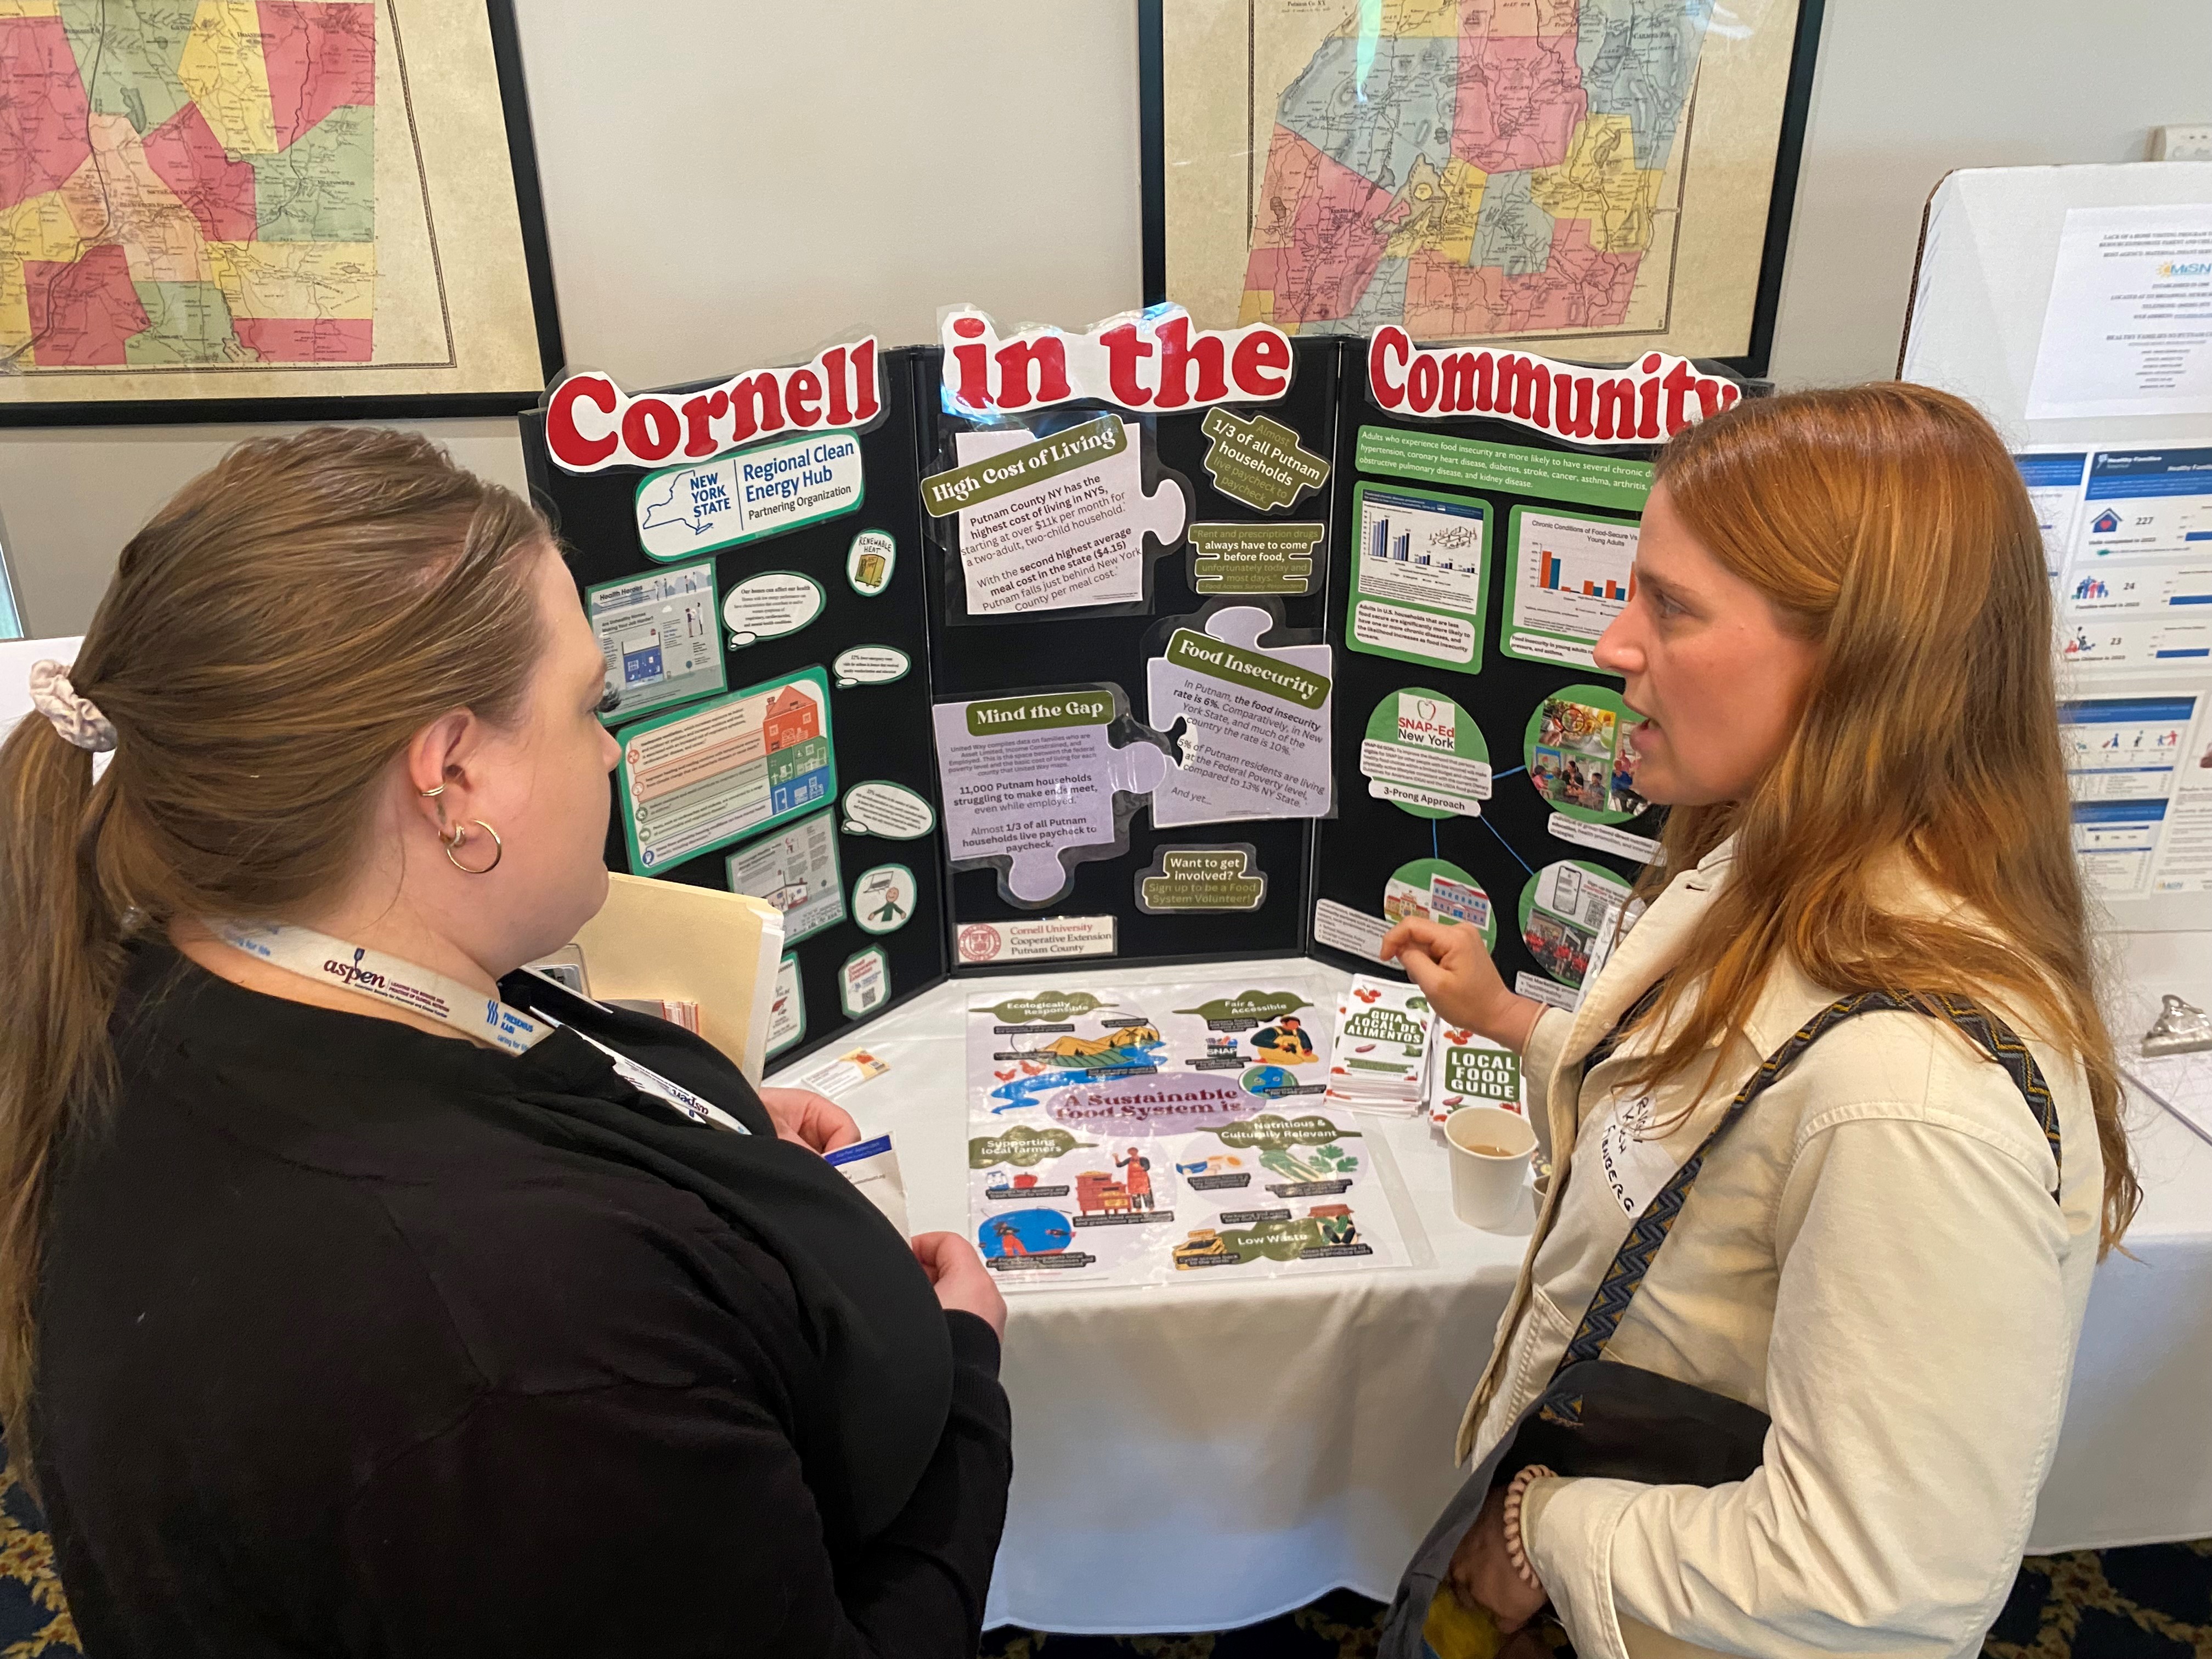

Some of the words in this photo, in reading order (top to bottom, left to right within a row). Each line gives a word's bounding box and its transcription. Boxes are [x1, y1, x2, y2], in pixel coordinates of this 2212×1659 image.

[953, 318, 1071, 409] in
[1100, 317, 1289, 408] the
[548, 339, 878, 466] Cornell
[1213, 420, 1236, 437] 1/3
[1237, 433, 1254, 445] of
[1252, 441, 1271, 455] all
[1271, 447, 1320, 480] Putnam
[1361, 431, 1383, 441] Adults
[1385, 435, 1400, 443] who
[1402, 438, 1438, 449] experience
[1441, 442, 1457, 451] food
[1459, 445, 1493, 458] insecurity
[1531, 454, 1550, 465] likely
[1563, 459, 1581, 469] have
[1583, 464, 1610, 472] several
[1612, 466, 1643, 476] chronic
[743, 448, 810, 482] Regional
[814, 443, 854, 463] Clean
[932, 476, 981, 502] High
[983, 460, 1025, 483] Cost
[1029, 449, 1048, 469] of
[1049, 427, 1116, 461] Living
[1219, 441, 1293, 486] households
[1359, 456, 1397, 467] obstructive
[1399, 462, 1435, 475] pulmonary
[1436, 467, 1463, 478] disease,
[1480, 473, 1503, 484] kidney
[1505, 477, 1533, 488] disease.
[690, 472, 718, 490] NEW
[746, 477, 799, 503] Energy
[803, 465, 832, 487] Hub
[691, 484, 726, 504] YORK
[748, 501, 795, 520] Partnering
[797, 486, 851, 507] Organization
[970, 509, 1009, 527] Putnam
[1011, 495, 1045, 512] County
[1048, 487, 1061, 499] NY
[1064, 483, 1082, 494] has
[1083, 476, 1100, 487] the
[693, 498, 731, 518] STATE
[970, 521, 1008, 539] highest
[1009, 514, 1031, 526] cost
[1032, 507, 1042, 518] of
[1043, 499, 1072, 514] living
[1072, 495, 1082, 504] in
[1084, 486, 1108, 499] NYS,
[961, 538, 999, 555] starting
[1000, 533, 1010, 543] at
[1012, 526, 1032, 538] over
[1035, 516, 1058, 530] $11k
[1059, 510, 1075, 523] per
[1077, 498, 1109, 515] month
[1111, 492, 1125, 503] for
[1532, 520, 1553, 528] Chronic
[1554, 523, 1583, 533] Conditions
[1592, 528, 1628, 539] Food-Secure
[859, 536, 891, 552] RENEWABLE
[974, 542, 1024, 563] two-adult,
[1025, 523, 1070, 546] two-child
[1205, 540, 1239, 551] always
[1241, 540, 1265, 549] have
[1588, 536, 1605, 545] Young
[977, 575, 1000, 588] With
[1002, 569, 1018, 579] the
[1020, 554, 1054, 573] second
[1056, 542, 1092, 560] highest
[1094, 528, 1131, 546] average
[1224, 552, 1257, 561] before
[1259, 552, 1284, 562] food,
[600, 591, 620, 601] Health
[622, 585, 643, 595] Heroes
[1179, 639, 1223, 665] Food
[1224, 654, 1318, 698] Insecurity
[977, 707, 1025, 724] Mind
[1030, 704, 1061, 718] the
[1065, 702, 1103, 718] Gap
[1184, 680, 1193, 689] In
[1195, 683, 1230, 700] Putnam,
[1235, 696, 1250, 706] the
[1251, 701, 1274, 714] food
[1274, 708, 1321, 732] insecurity
[1399, 718, 1454, 737] SNAP-Ed
[1398, 729, 1424, 742] New
[1429, 734, 1453, 749] York
[960, 784, 994, 795] 11,000
[996, 781, 1034, 790] Putnam
[1036, 774, 1092, 786] households
[953, 794, 1002, 806] struggling
[1017, 790, 1042, 798] make
[1045, 786, 1068, 795] ends
[1070, 785, 1098, 793] meet,
[1384, 787, 1419, 802] 3-Prong
[1421, 794, 1465, 810] Approach
[1170, 858, 1201, 867] Want
[1205, 859, 1217, 867] to
[1220, 859, 1240, 870] get
[1175, 871, 1233, 881] involved?
[1010, 926, 1043, 935] Cornell
[1046, 924, 1093, 933] University
[1010, 935, 1065, 946] Cooperative
[1068, 933, 1114, 942] Extension
[1011, 947, 1048, 955] Putnam
[1050, 945, 1085, 953] County
[324, 960, 385, 988] aspen
[1007, 1002, 1070, 1011] Ecologically
[1025, 1005, 1089, 1015] Responsible
[1231, 1003, 1287, 1014] Accessible
[1355, 1017, 1395, 1030] LOCAL
[1401, 1024, 1417, 1034] DE
[1372, 1011, 1402, 1023] GUIA
[1347, 1025, 1421, 1043] ALIMENTOS
[1207, 1048, 1237, 1057] SNAP
[1452, 1052, 1516, 1070] LOCAL
[1456, 1066, 1510, 1084] FOOD
[1064, 1095, 1083, 1107] A
[1088, 1088, 1238, 1105] Sustainable
[1451, 1079, 1515, 1098] GUIDE
[1056, 1107, 1114, 1120] Food
[1121, 1103, 1214, 1120] System
[1221, 1130, 1281, 1139] Culturally
[1284, 1130, 1338, 1138] Relevant
[1254, 1121, 1315, 1130] Nutritious
[987, 1139, 1056, 1149] Supporting
[1013, 1145, 1062, 1154] farmers
[1238, 1235, 1264, 1246] Low
[1267, 1233, 1307, 1243] Waste
